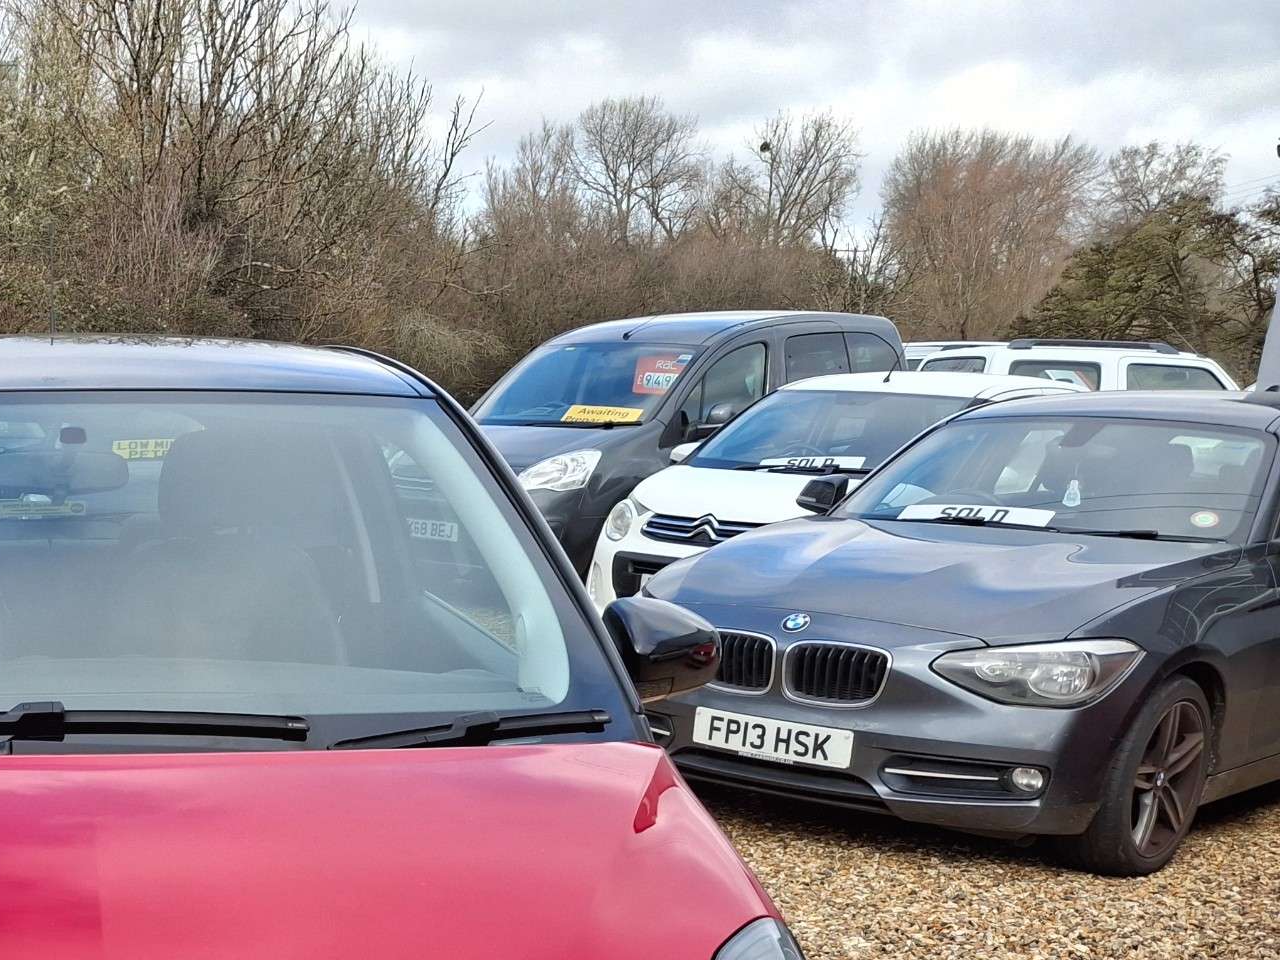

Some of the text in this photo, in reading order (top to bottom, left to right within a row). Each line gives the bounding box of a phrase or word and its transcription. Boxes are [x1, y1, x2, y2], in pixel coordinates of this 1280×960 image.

[577, 407, 630, 418] Awaiting
[939, 506, 1011, 523] SOLD
[708, 715, 766, 750] FP13
[773, 726, 832, 761] HSK
